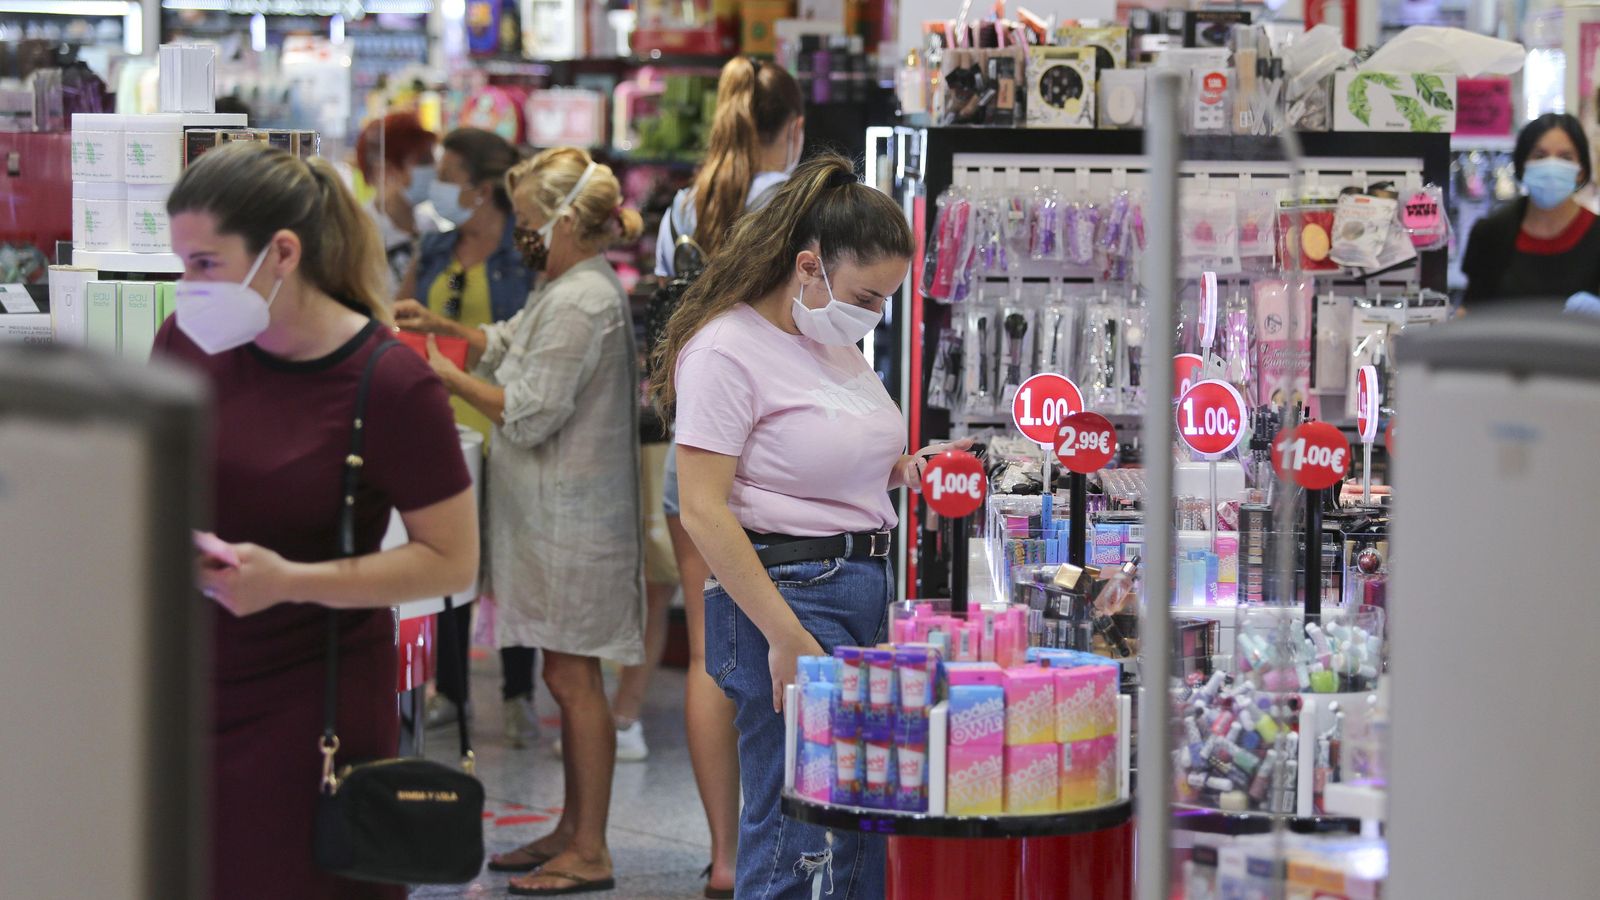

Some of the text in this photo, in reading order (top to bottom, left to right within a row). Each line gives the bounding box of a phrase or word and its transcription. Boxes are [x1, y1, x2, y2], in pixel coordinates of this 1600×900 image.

[94, 292, 110, 301] eau
[128, 294, 147, 303] eau
[1020, 388, 1076, 427] 1.00
[1183, 398, 1236, 436] 1.00€
[1058, 426, 1110, 457] 2.99€
[926, 467, 981, 500] 1.00€
